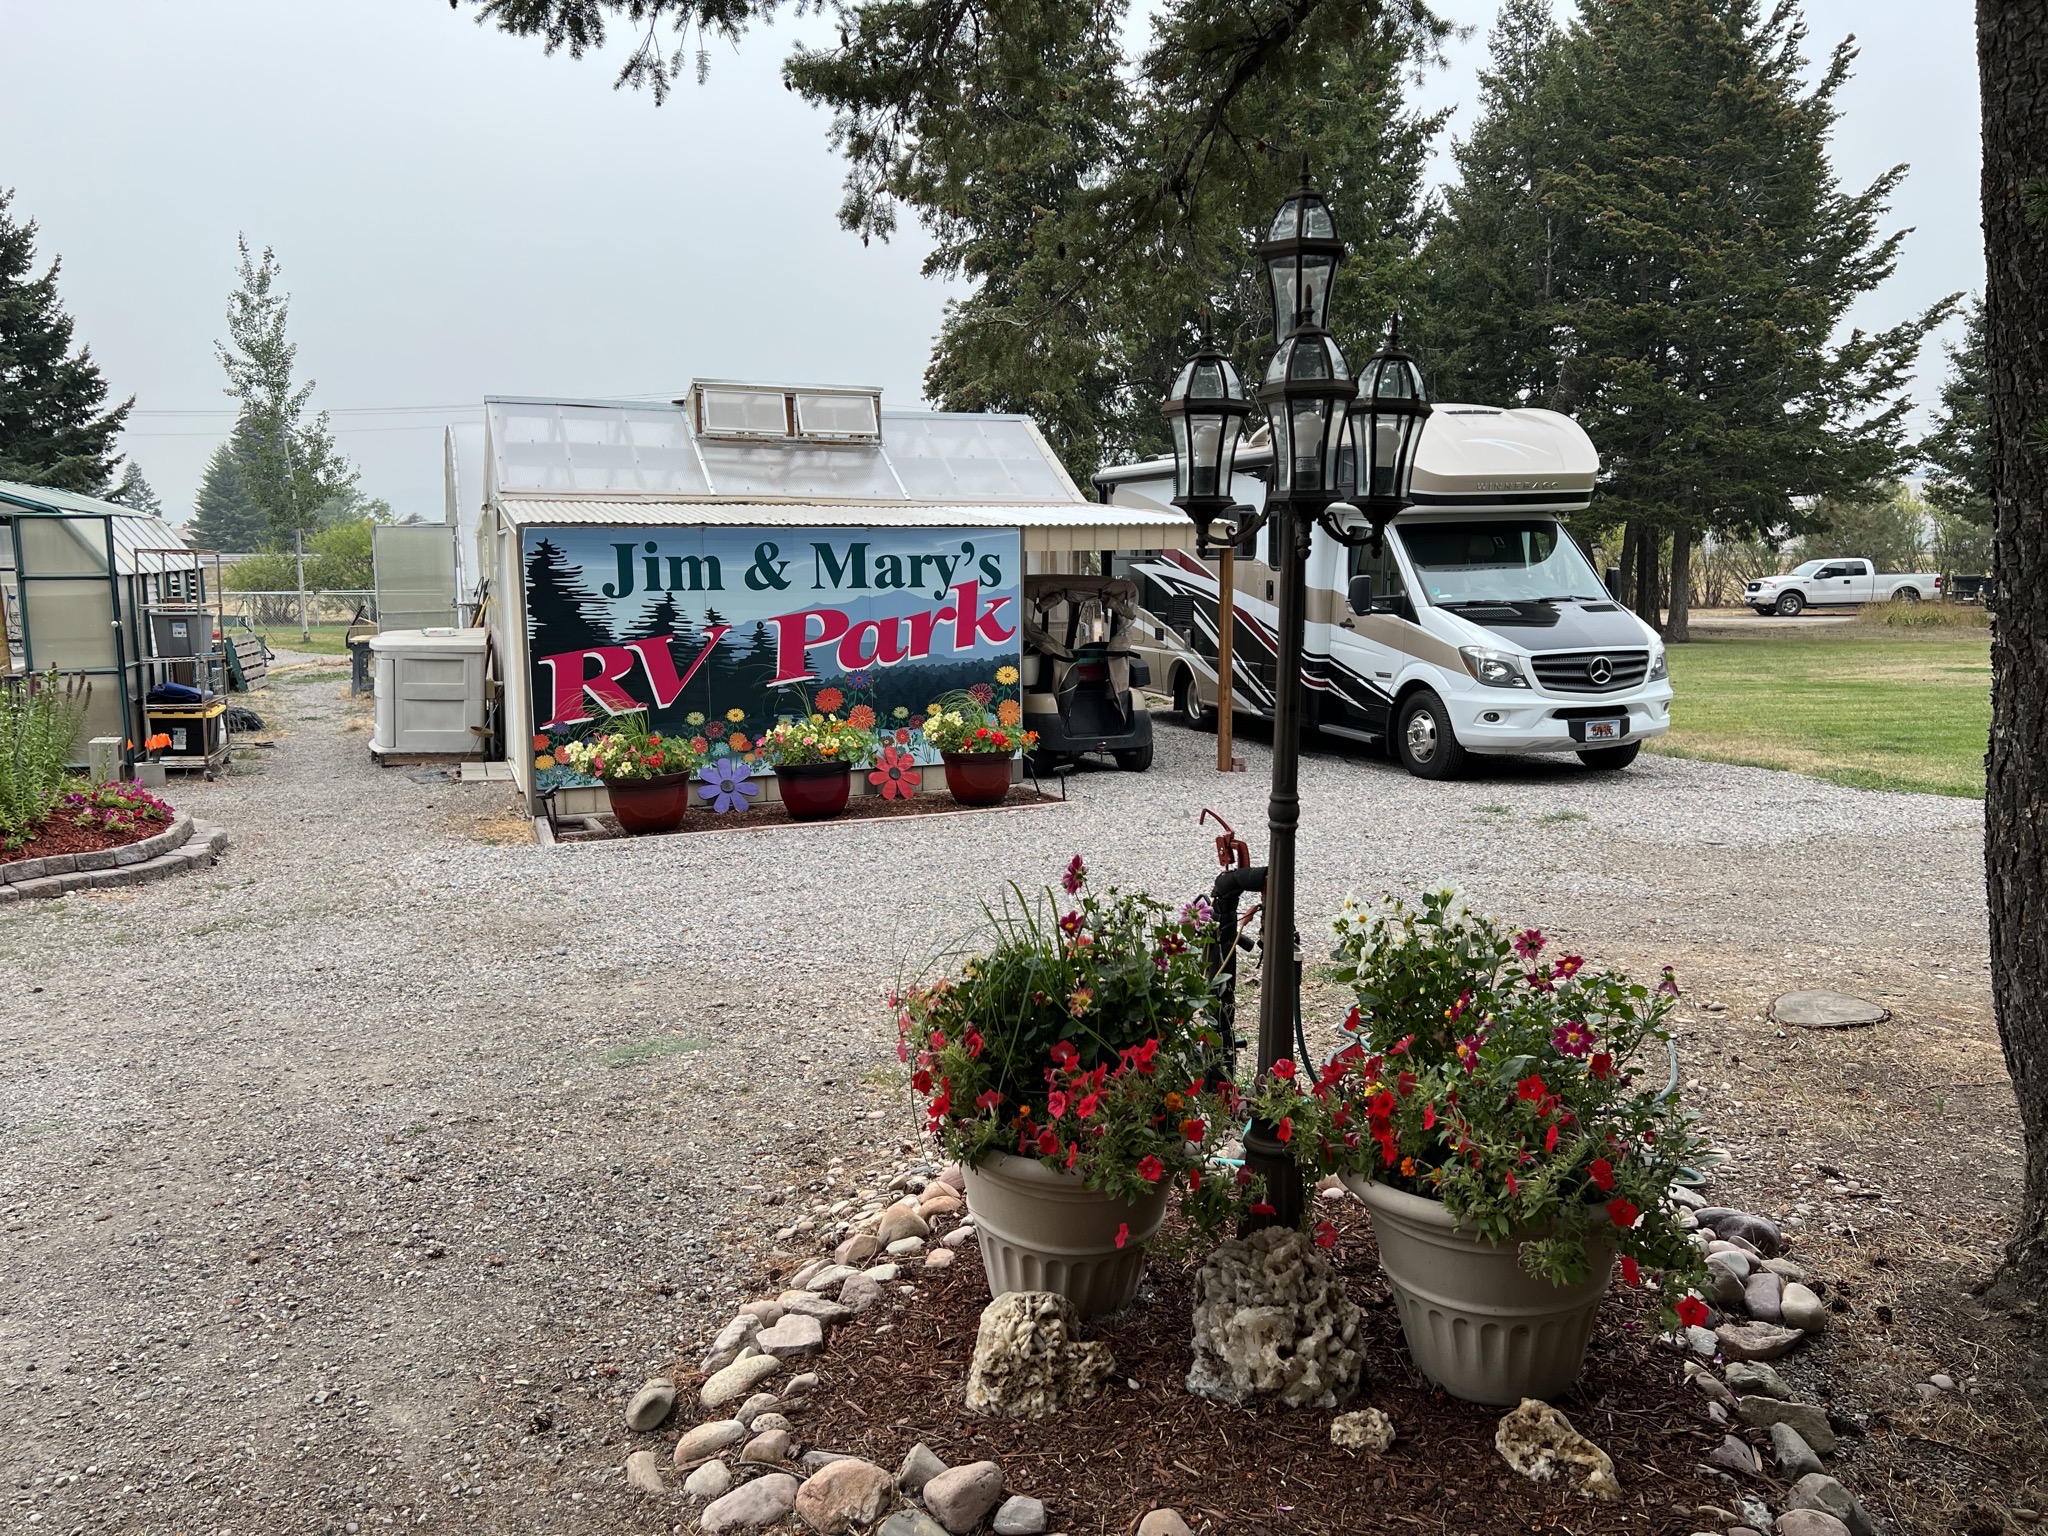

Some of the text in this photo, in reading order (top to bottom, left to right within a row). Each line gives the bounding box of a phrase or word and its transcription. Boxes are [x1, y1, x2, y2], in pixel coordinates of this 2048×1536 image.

[602, 541, 1002, 601] Jim & Mary's
[538, 579, 1017, 730] RV Park
